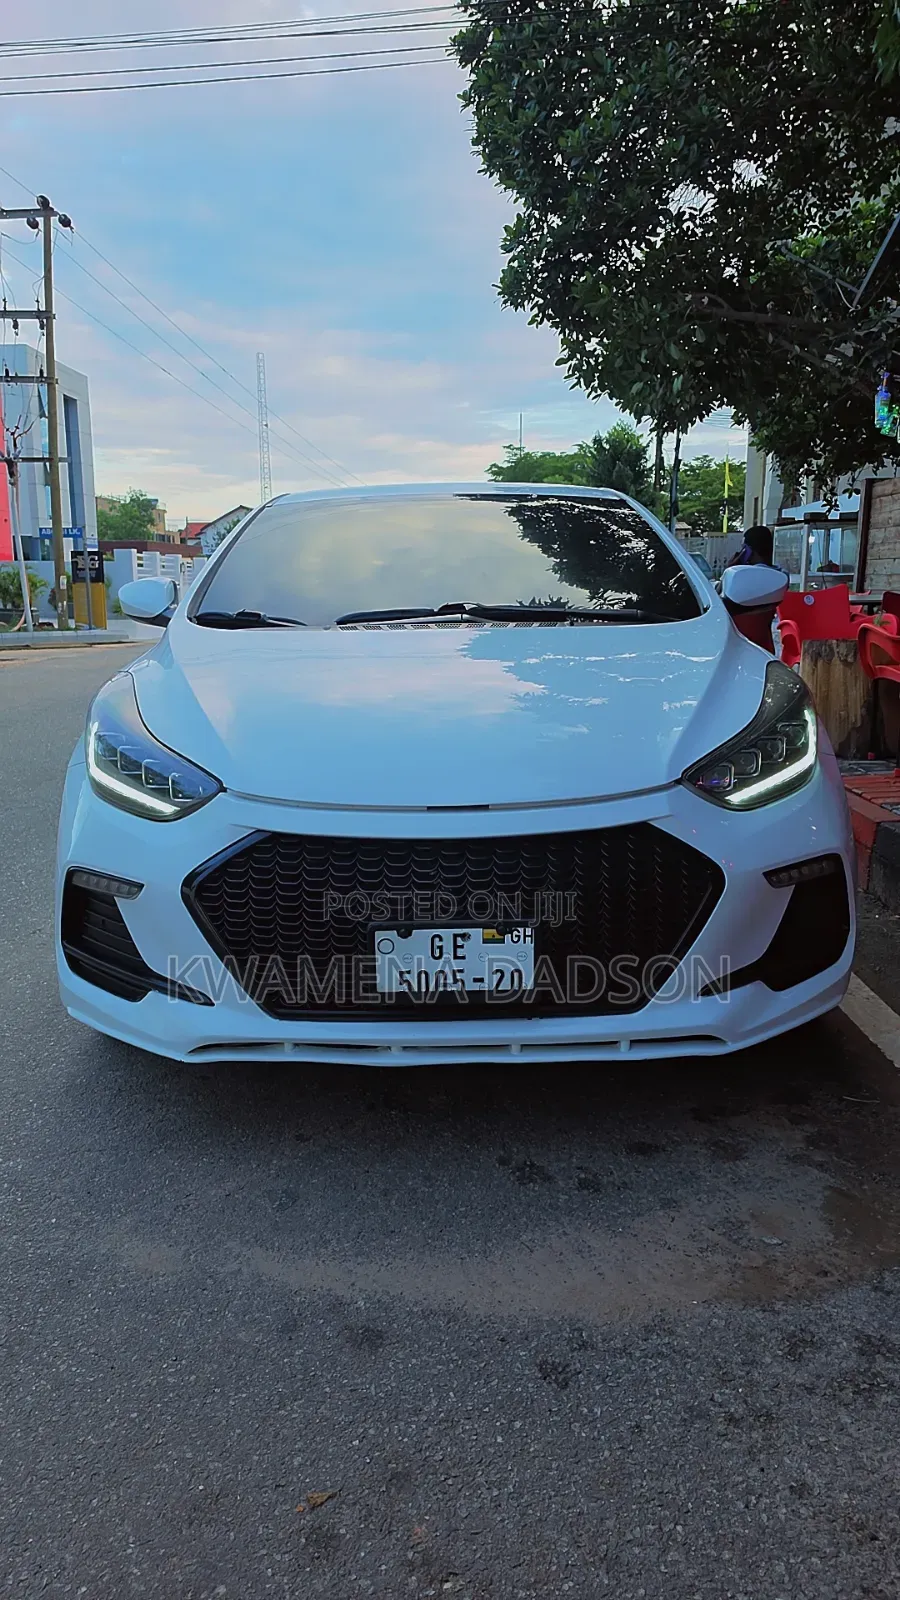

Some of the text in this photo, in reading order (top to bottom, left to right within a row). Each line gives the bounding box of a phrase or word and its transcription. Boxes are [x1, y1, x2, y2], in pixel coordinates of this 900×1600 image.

[430, 933, 467, 960] GE
[510, 928, 534, 944] GH
[398, 968, 523, 992] 5005-20
